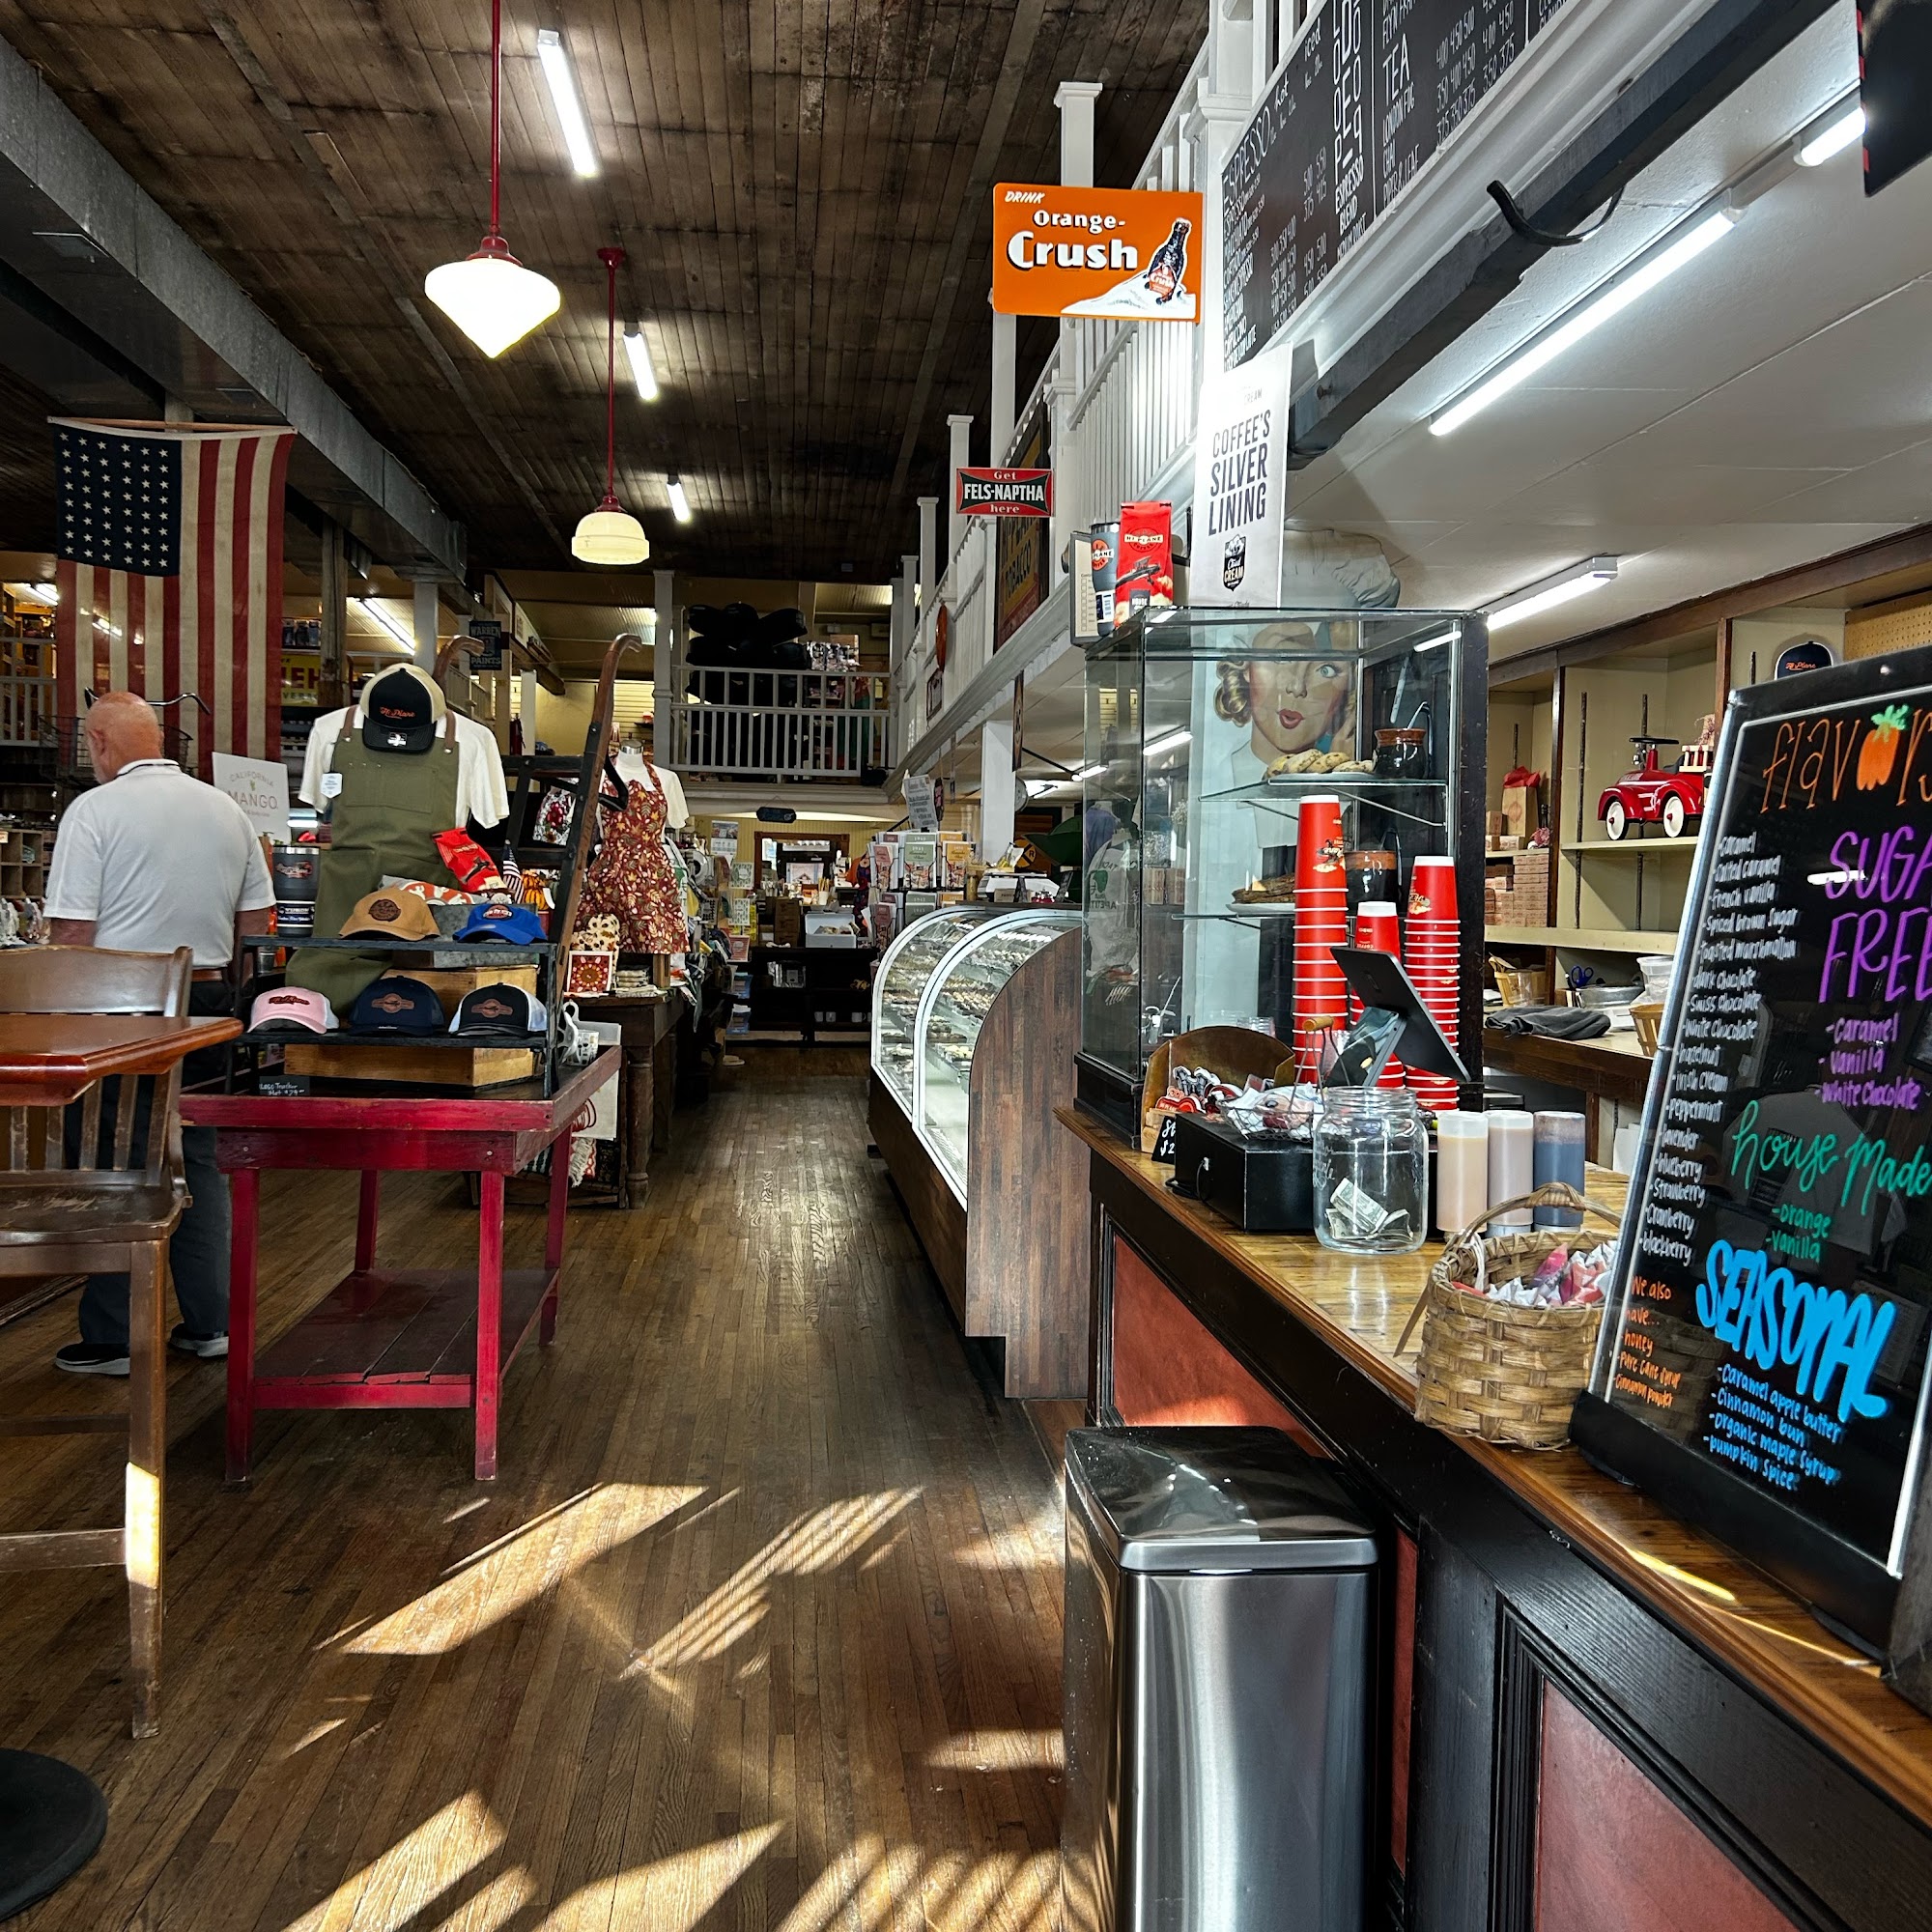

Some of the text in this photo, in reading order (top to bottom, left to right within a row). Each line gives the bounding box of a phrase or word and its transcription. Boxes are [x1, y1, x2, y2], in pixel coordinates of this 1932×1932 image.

[1383, 33, 1410, 107] TEA
[1223, 105, 1270, 218] ESPRESSO
[1005, 190, 1045, 204] DRINK
[1336, 155, 1364, 214] ESPRESSO
[1033, 210, 1125, 235] Orange-
[1340, 195, 1358, 236] BLEND
[1008, 231, 1138, 271] Crush
[1212, 410, 1271, 459] COFFEE'S
[994, 470, 1016, 480] Get
[1210, 442, 1267, 497] SILVER
[964, 484, 1044, 501] FELS-NAPTHA
[990, 504, 1019, 514] here
[1208, 483, 1265, 536] LINING
[1225, 566, 1244, 583] CREAM
[1029, 849, 1036, 858] R
[1819, 906, 1932, 1003] FREE
[1648, 1281, 1672, 1300] also
[1695, 1239, 1896, 1423] SEASONAL
[1770, 1390, 1802, 1421] apple
[1804, 1406, 1842, 1444] butter
[1778, 1417, 1805, 1448] bun
[1760, 1434, 1797, 1465] maple
